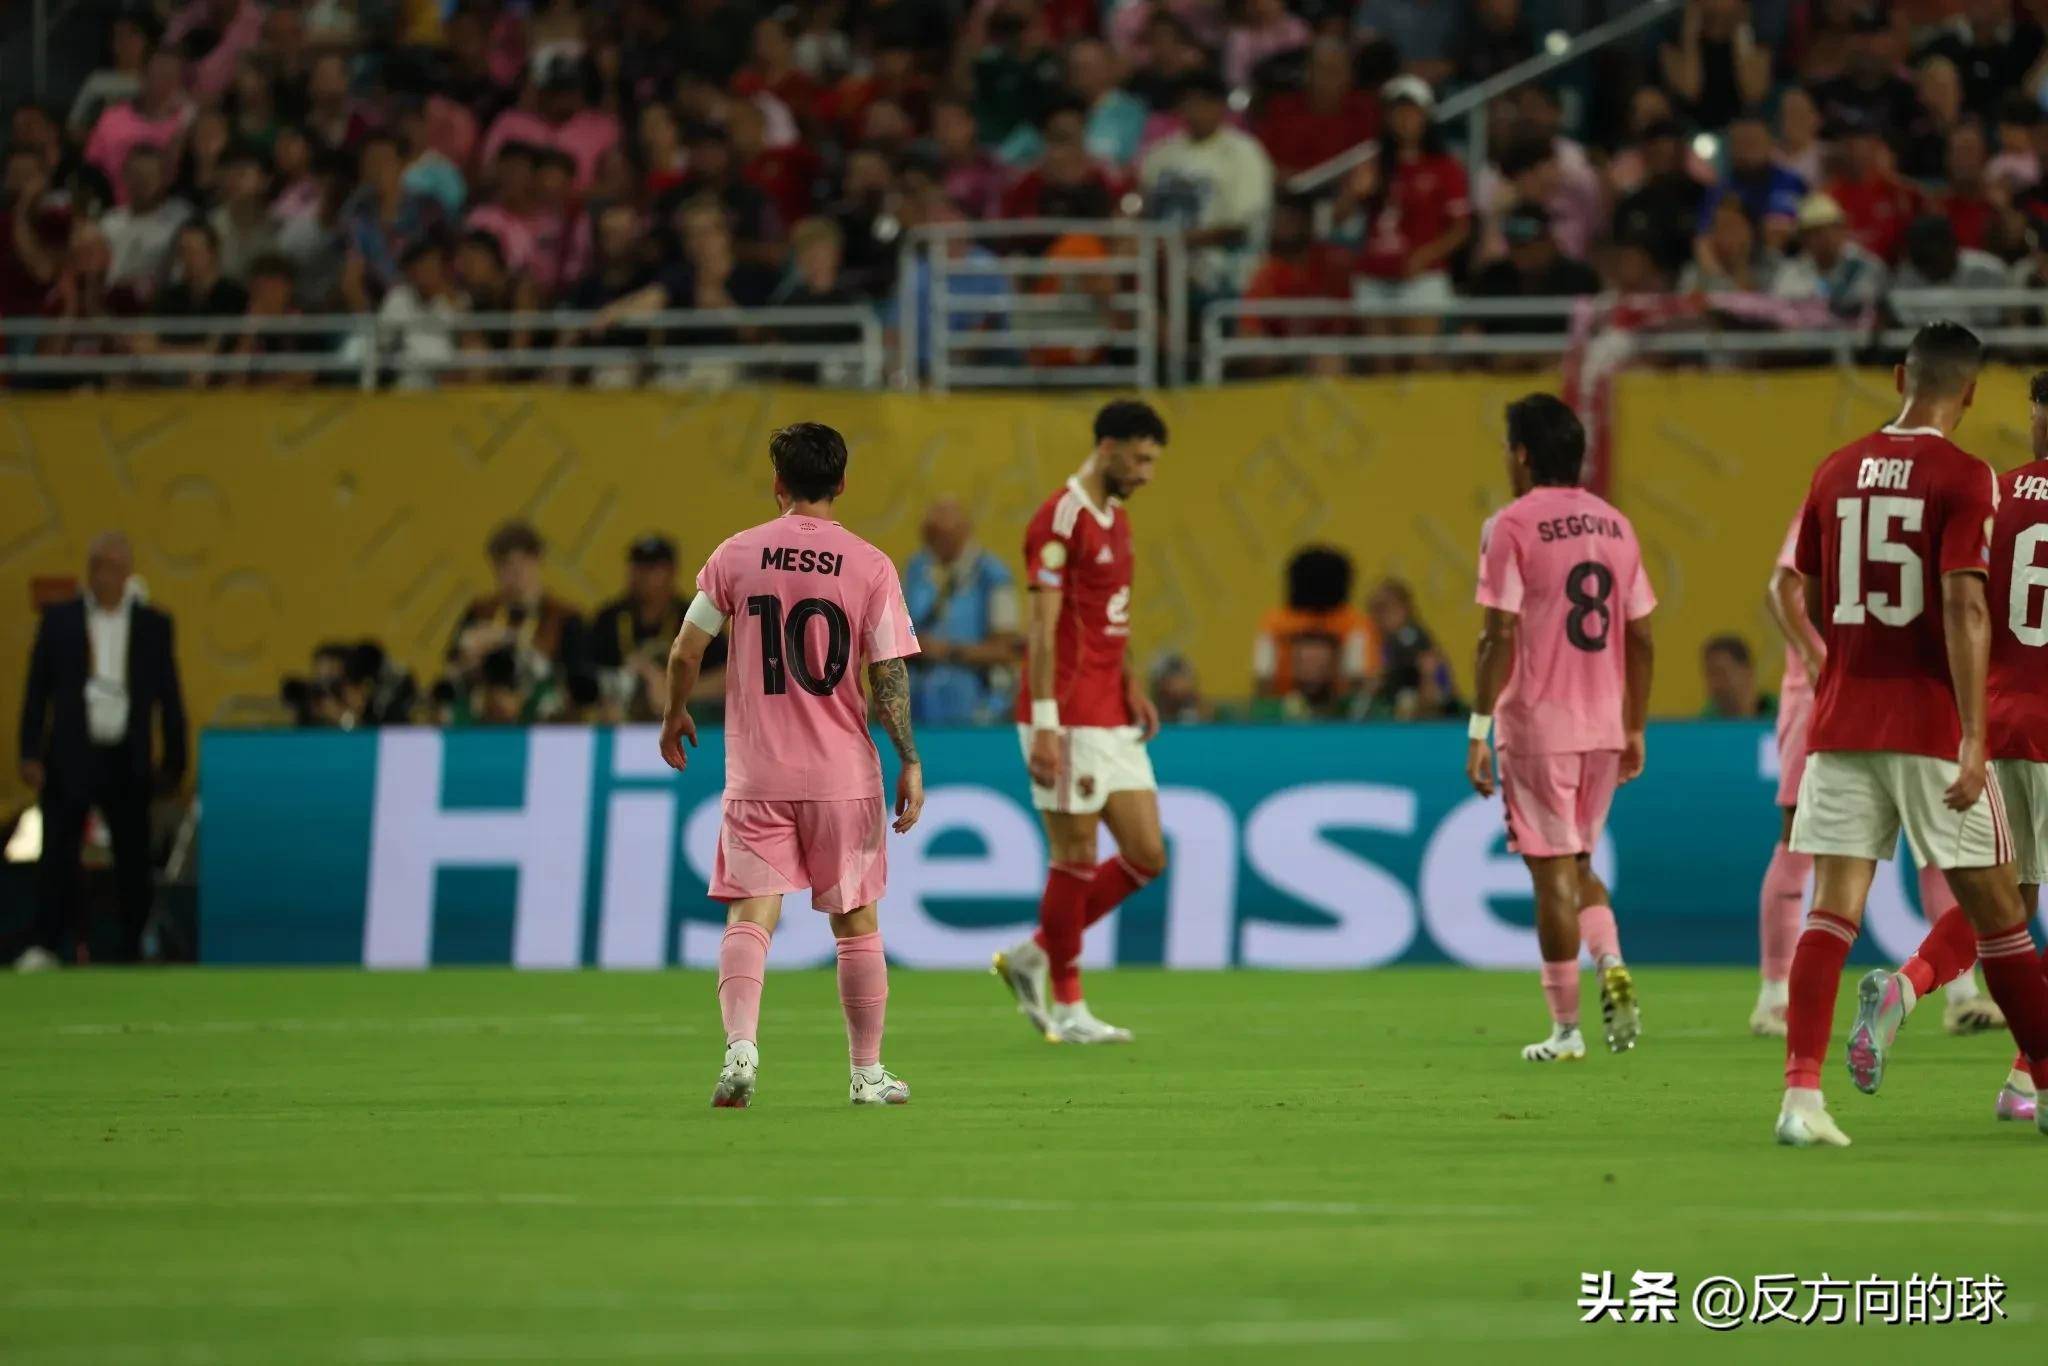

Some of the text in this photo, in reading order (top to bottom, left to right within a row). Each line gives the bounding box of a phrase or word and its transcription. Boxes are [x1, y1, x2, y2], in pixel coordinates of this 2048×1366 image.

[1857, 457, 1914, 490] DARI
[1537, 513, 1624, 543] SEGOVIA
[760, 547, 843, 577] MESSI
[1832, 495, 1925, 627] 15
[1565, 561, 1613, 653] 8
[747, 594, 851, 697] 10
